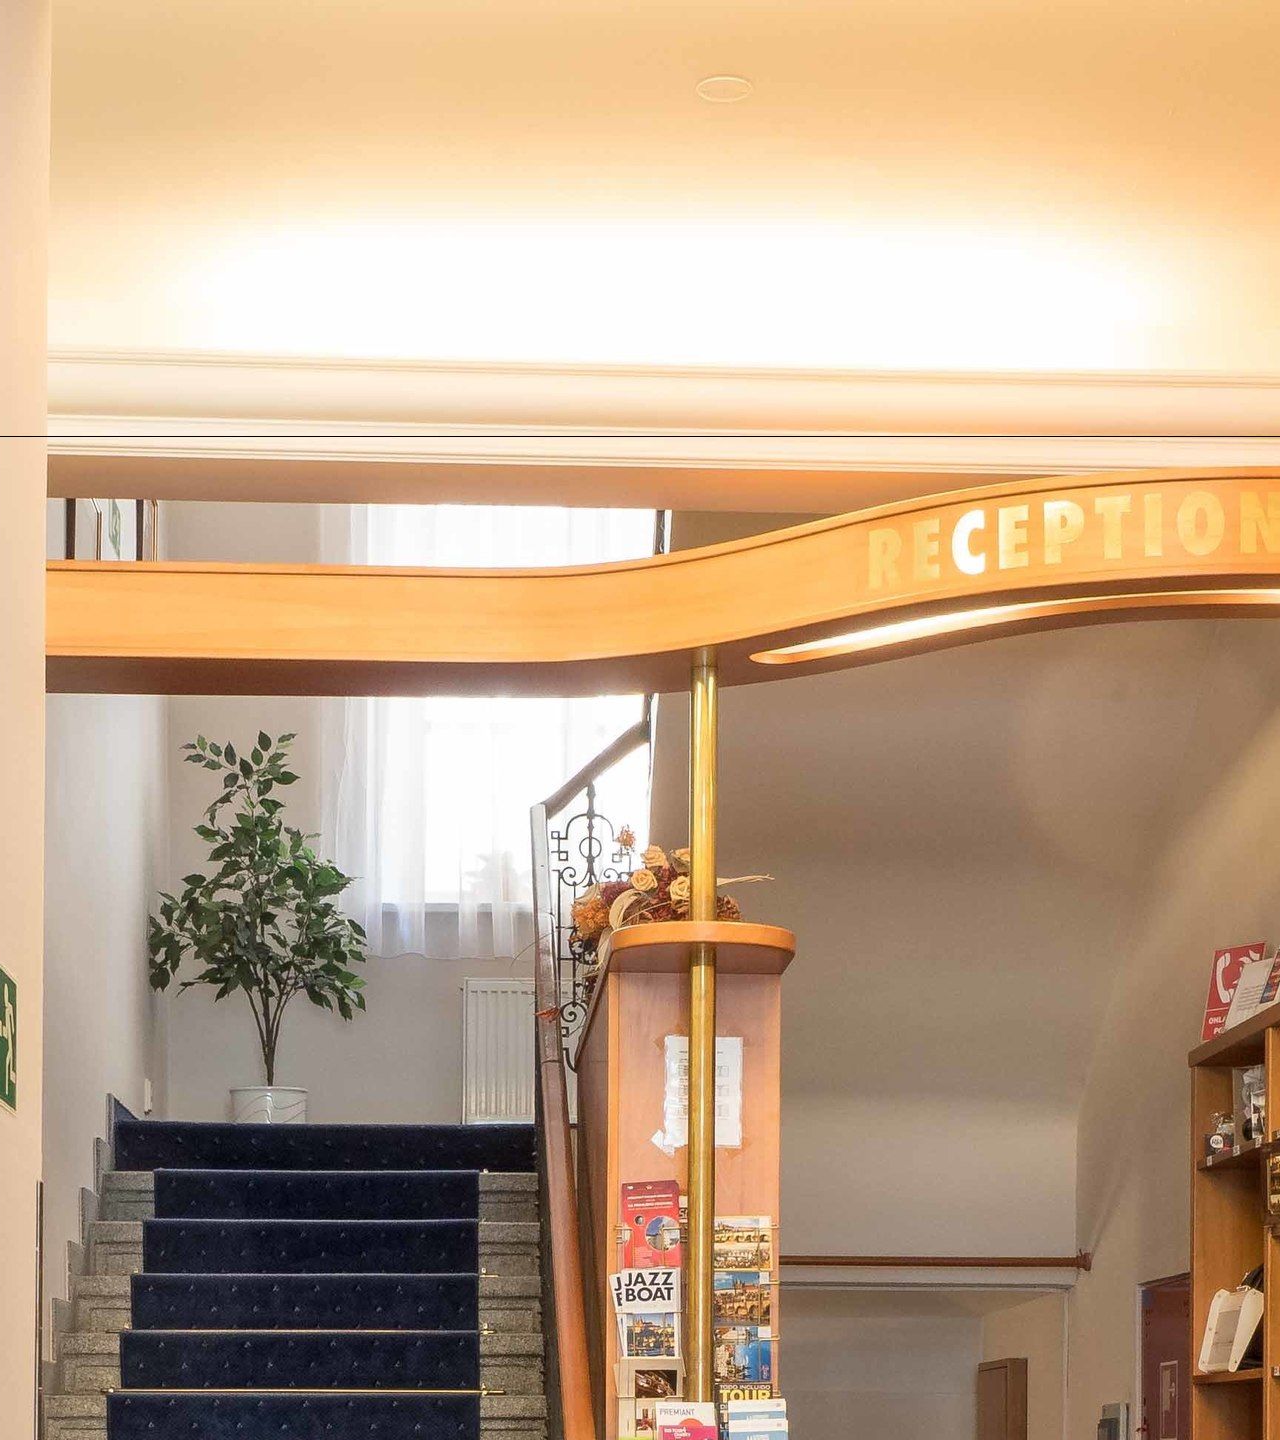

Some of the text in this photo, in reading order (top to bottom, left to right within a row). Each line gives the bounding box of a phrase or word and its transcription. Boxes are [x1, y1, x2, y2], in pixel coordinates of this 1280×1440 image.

[624, 1272, 673, 1287] JAZZ
[625, 1287, 674, 1302] BOAT
[720, 1389, 771, 1403] TOUR
[659, 1408, 696, 1416] PREMIANT
